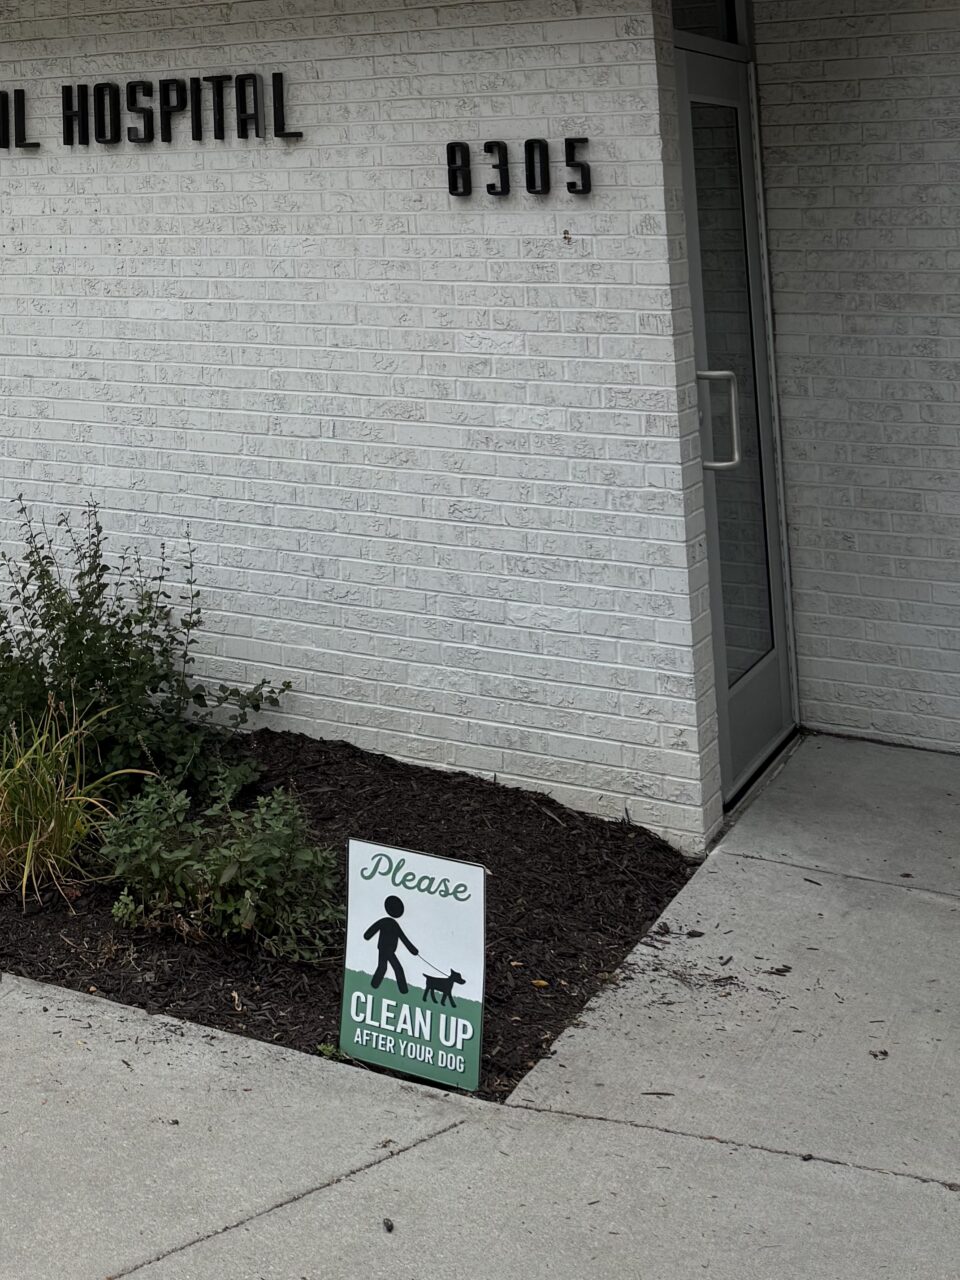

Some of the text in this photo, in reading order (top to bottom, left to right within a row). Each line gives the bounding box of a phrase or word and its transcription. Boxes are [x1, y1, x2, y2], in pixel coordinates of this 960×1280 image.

[62, 72, 303, 147] HOSPITAL
[446, 137, 592, 196] 8305
[360, 852, 471, 902] Please
[350, 991, 473, 1050] CLEAN UP
[353, 1028, 465, 1073] AFTER YOUR DOG
